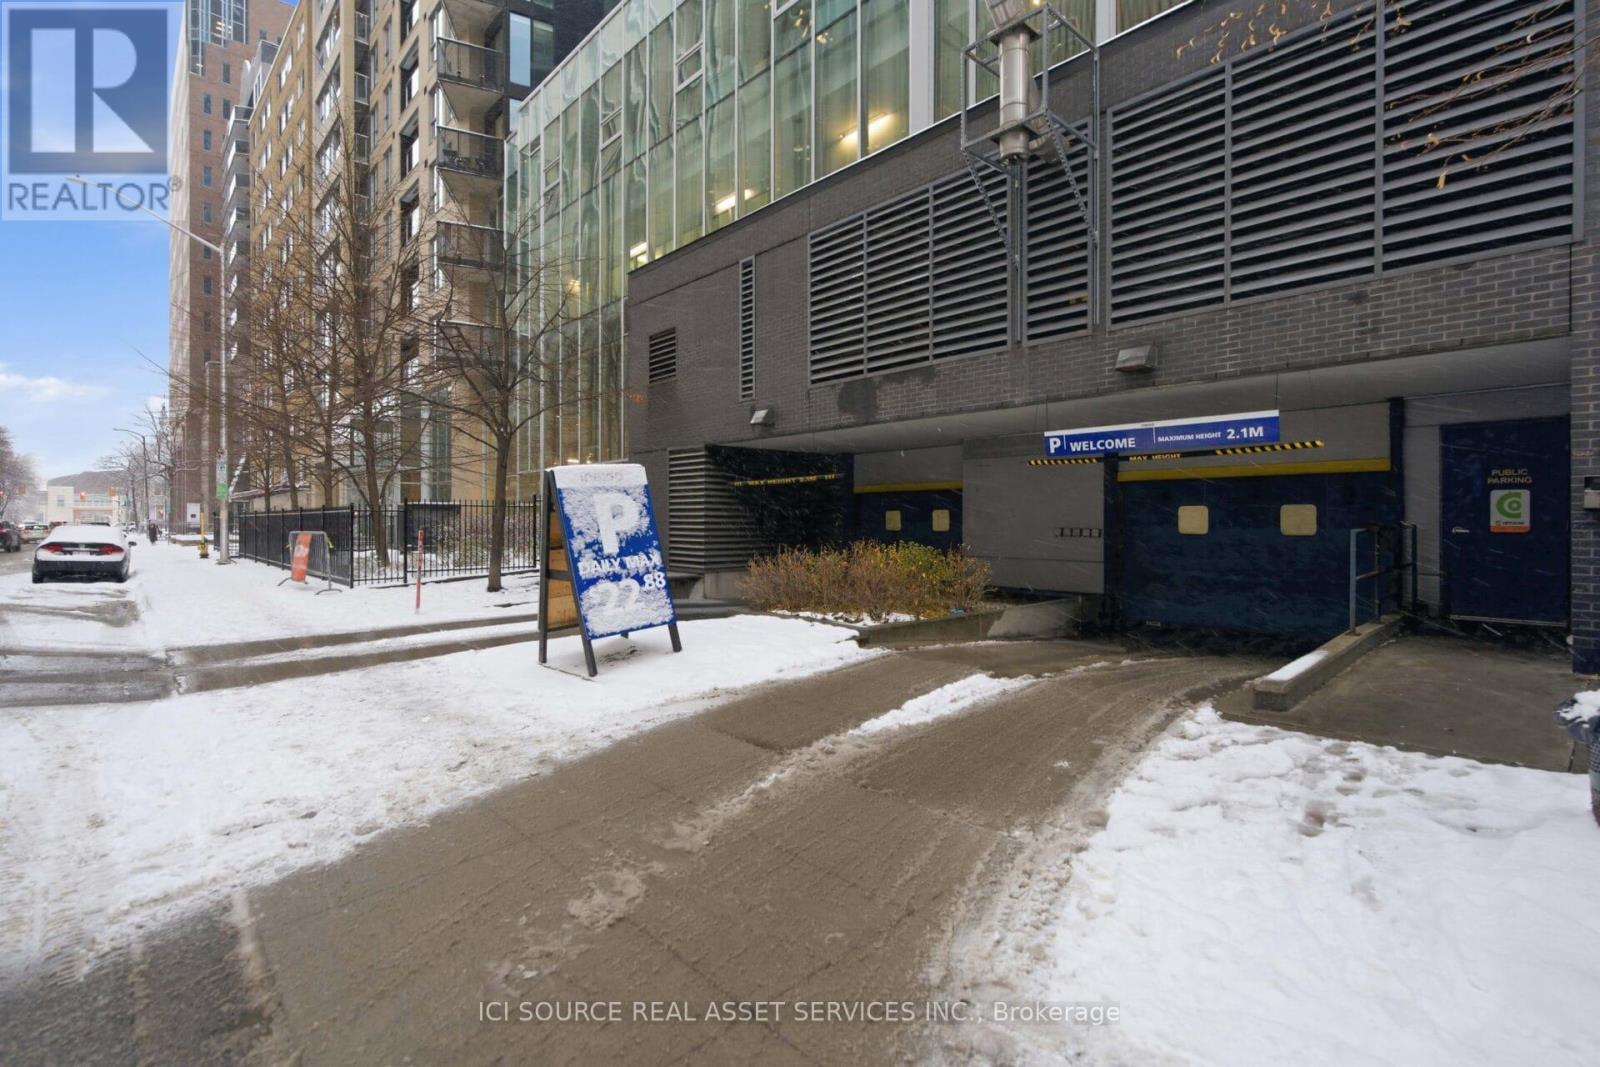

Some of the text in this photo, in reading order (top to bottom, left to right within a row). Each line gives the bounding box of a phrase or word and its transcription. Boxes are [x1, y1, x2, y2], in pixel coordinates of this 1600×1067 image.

[1158, 426, 1264, 442] MAXIMUM HEIGHT 2.1M
[1049, 438, 1136, 454] P WELCOME
[1488, 476, 1532, 484] PARKING
[577, 551, 661, 577] DAILY MAX
